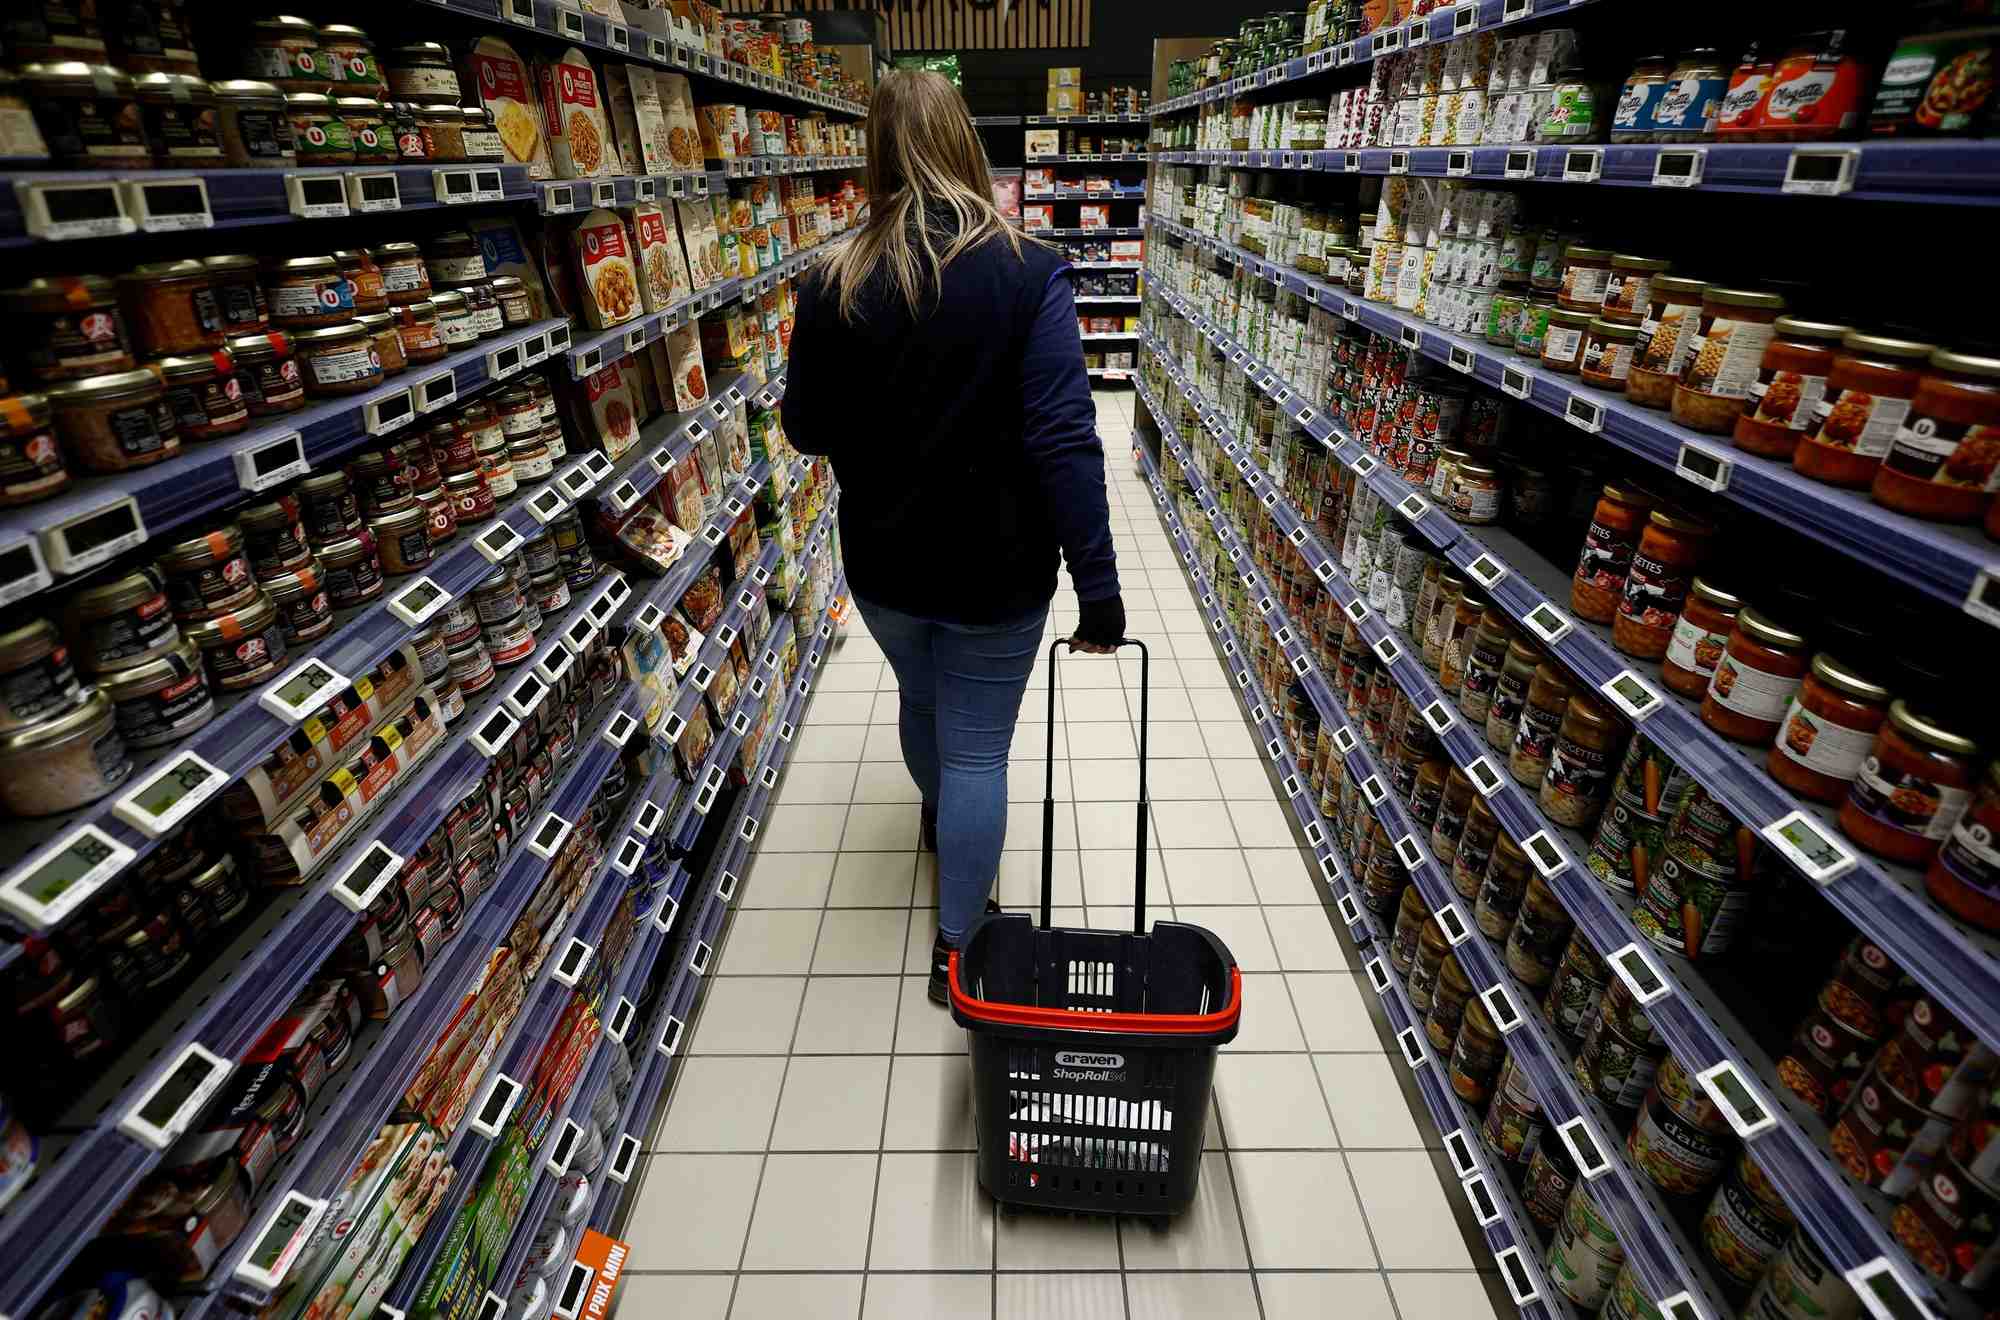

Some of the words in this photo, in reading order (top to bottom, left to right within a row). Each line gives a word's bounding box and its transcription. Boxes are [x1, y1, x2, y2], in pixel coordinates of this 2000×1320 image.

[1062, 1053, 1118, 1066] araven
[600, 1243, 627, 1281] MINI
[588, 1280, 613, 1316] PRIX
